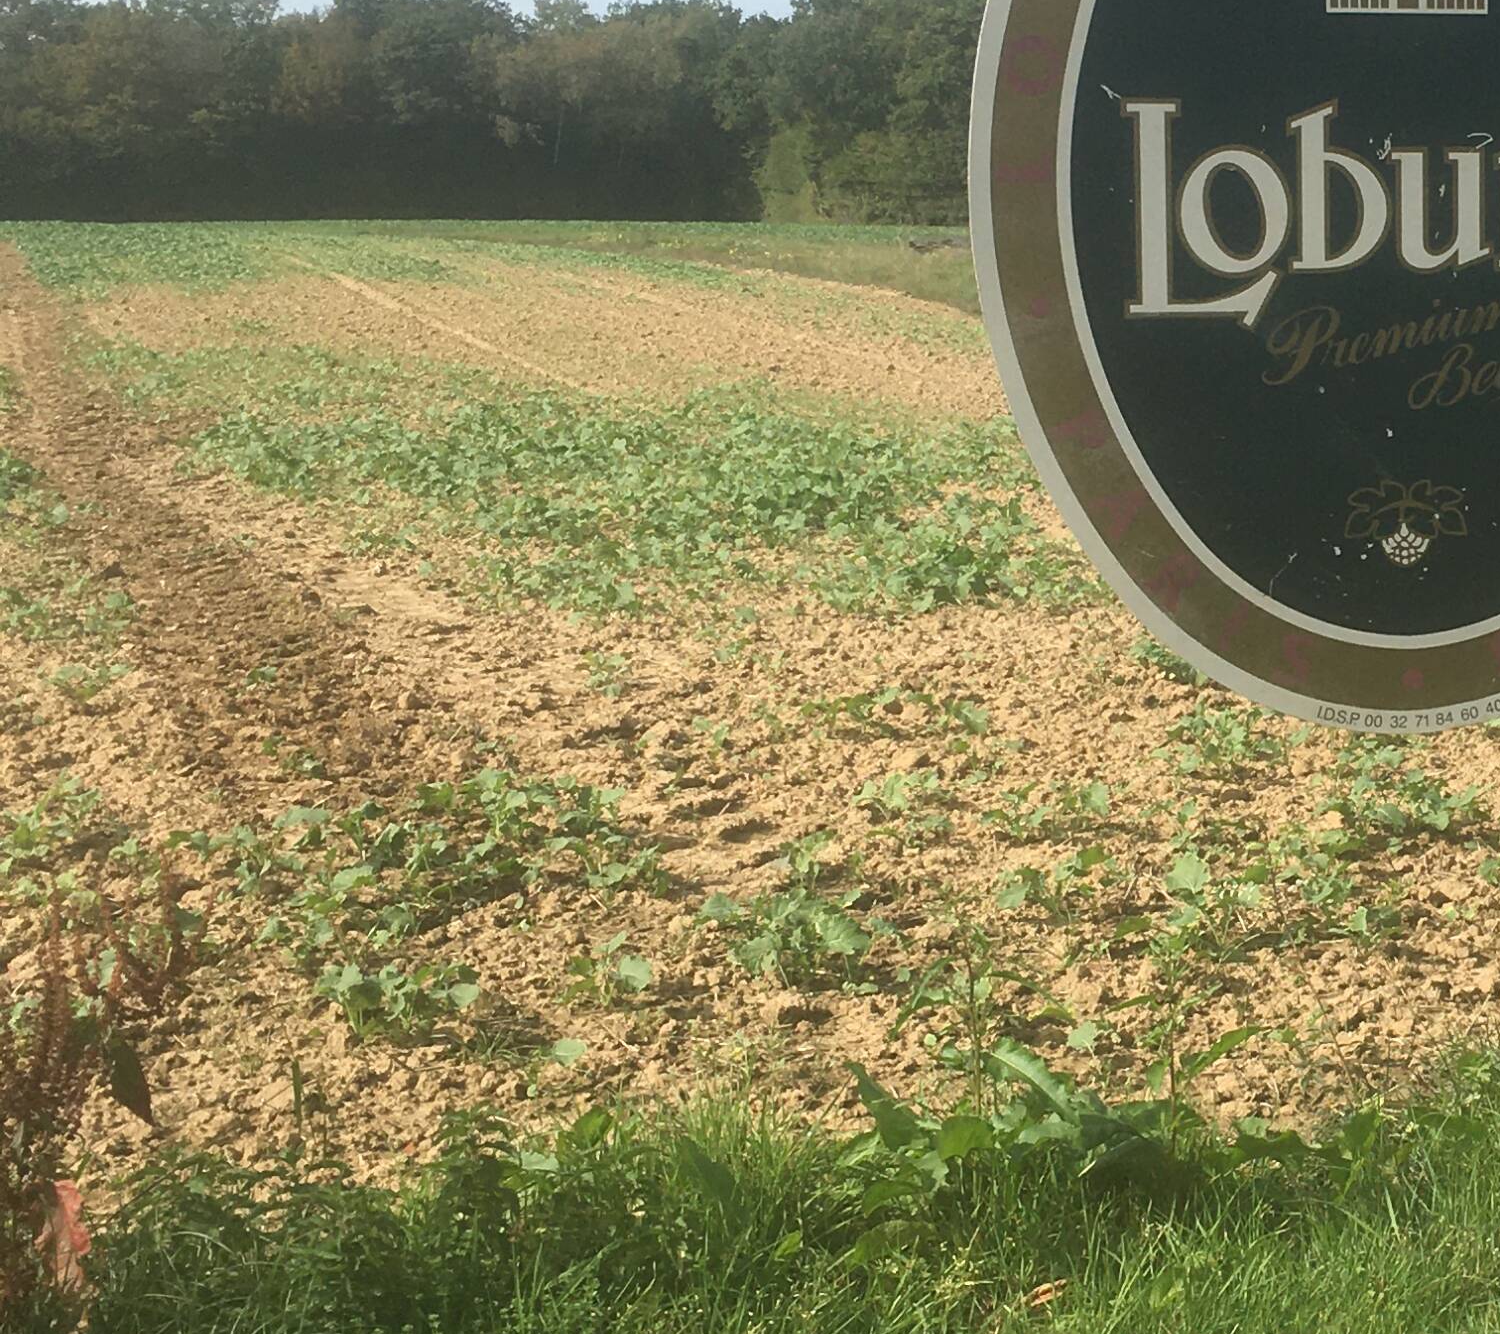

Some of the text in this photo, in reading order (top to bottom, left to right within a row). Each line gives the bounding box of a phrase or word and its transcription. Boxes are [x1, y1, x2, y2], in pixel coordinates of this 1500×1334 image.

[1364, 714, 1383, 728] 00
[1390, 715, 1408, 729] 32
[1415, 714, 1430, 728] 71
[1436, 711, 1454, 726] 84
[1460, 705, 1479, 721] 60
